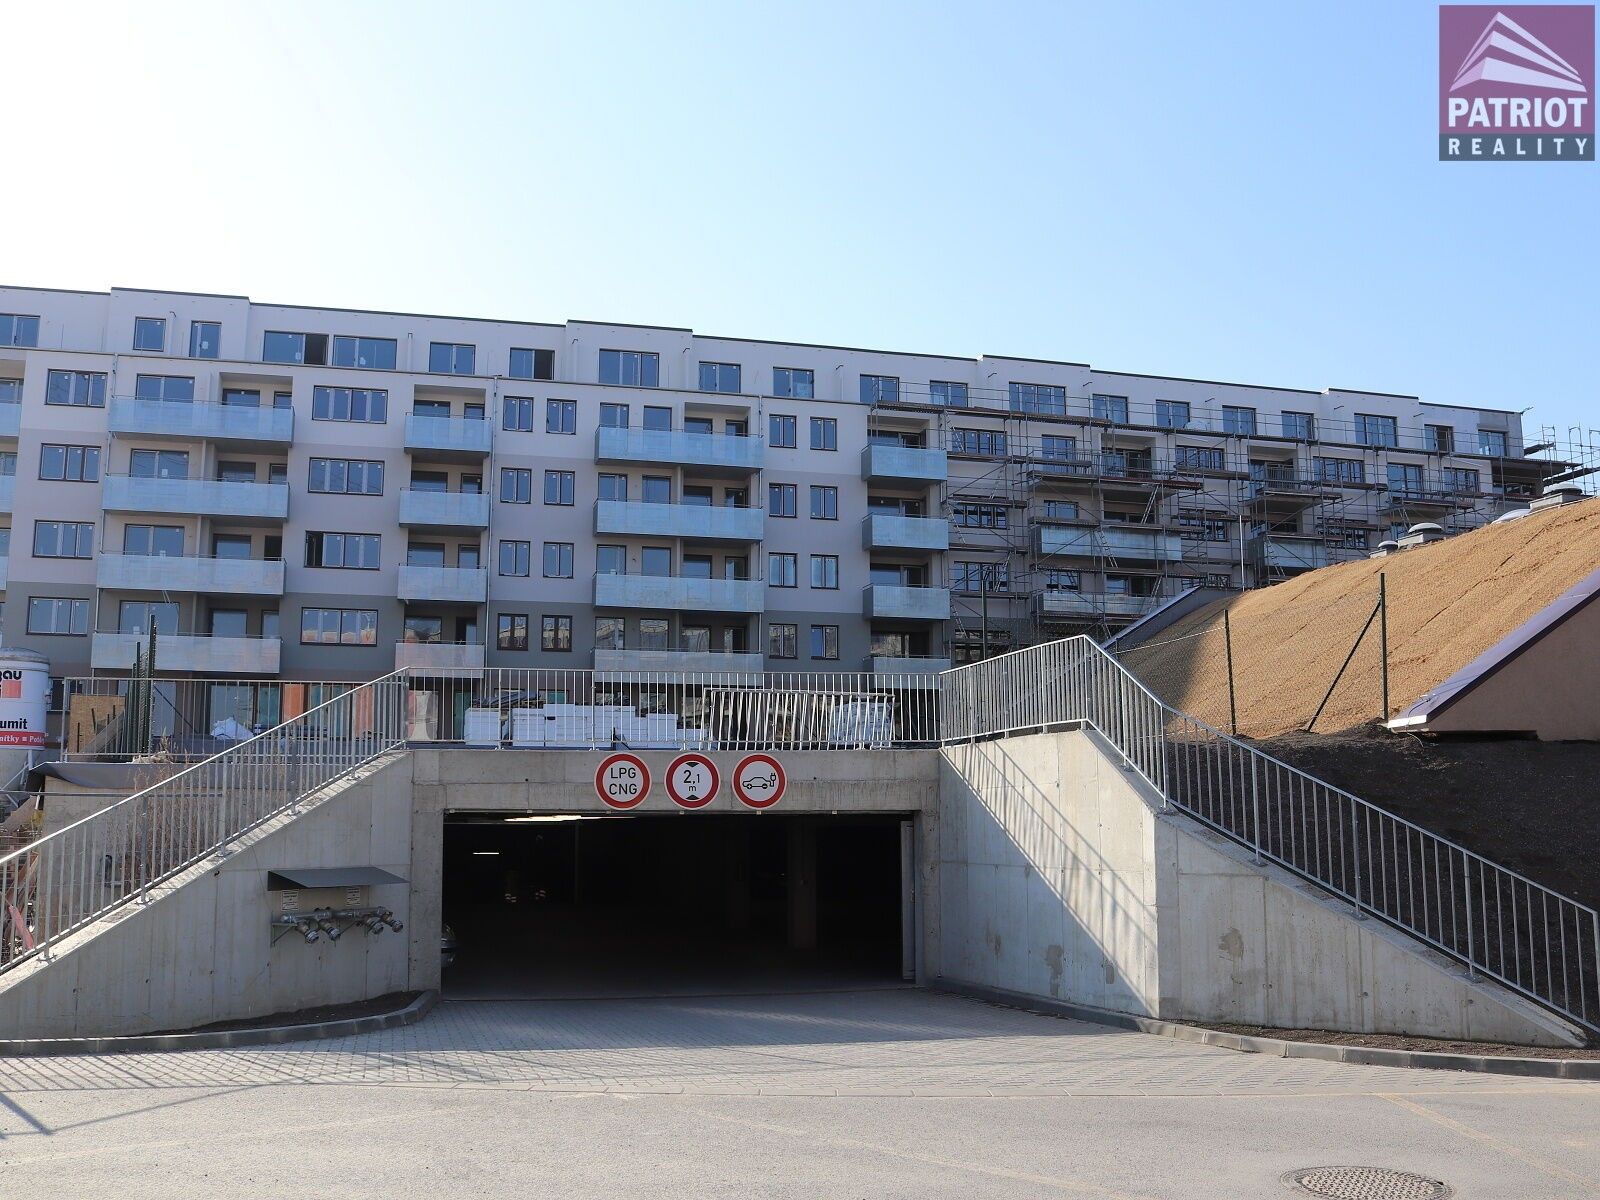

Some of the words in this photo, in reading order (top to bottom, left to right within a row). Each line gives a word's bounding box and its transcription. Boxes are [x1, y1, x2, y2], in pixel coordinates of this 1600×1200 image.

[610, 767, 636, 779] LPG
[683, 769, 701, 785] 2,1
[608, 783, 638, 795] CNG
